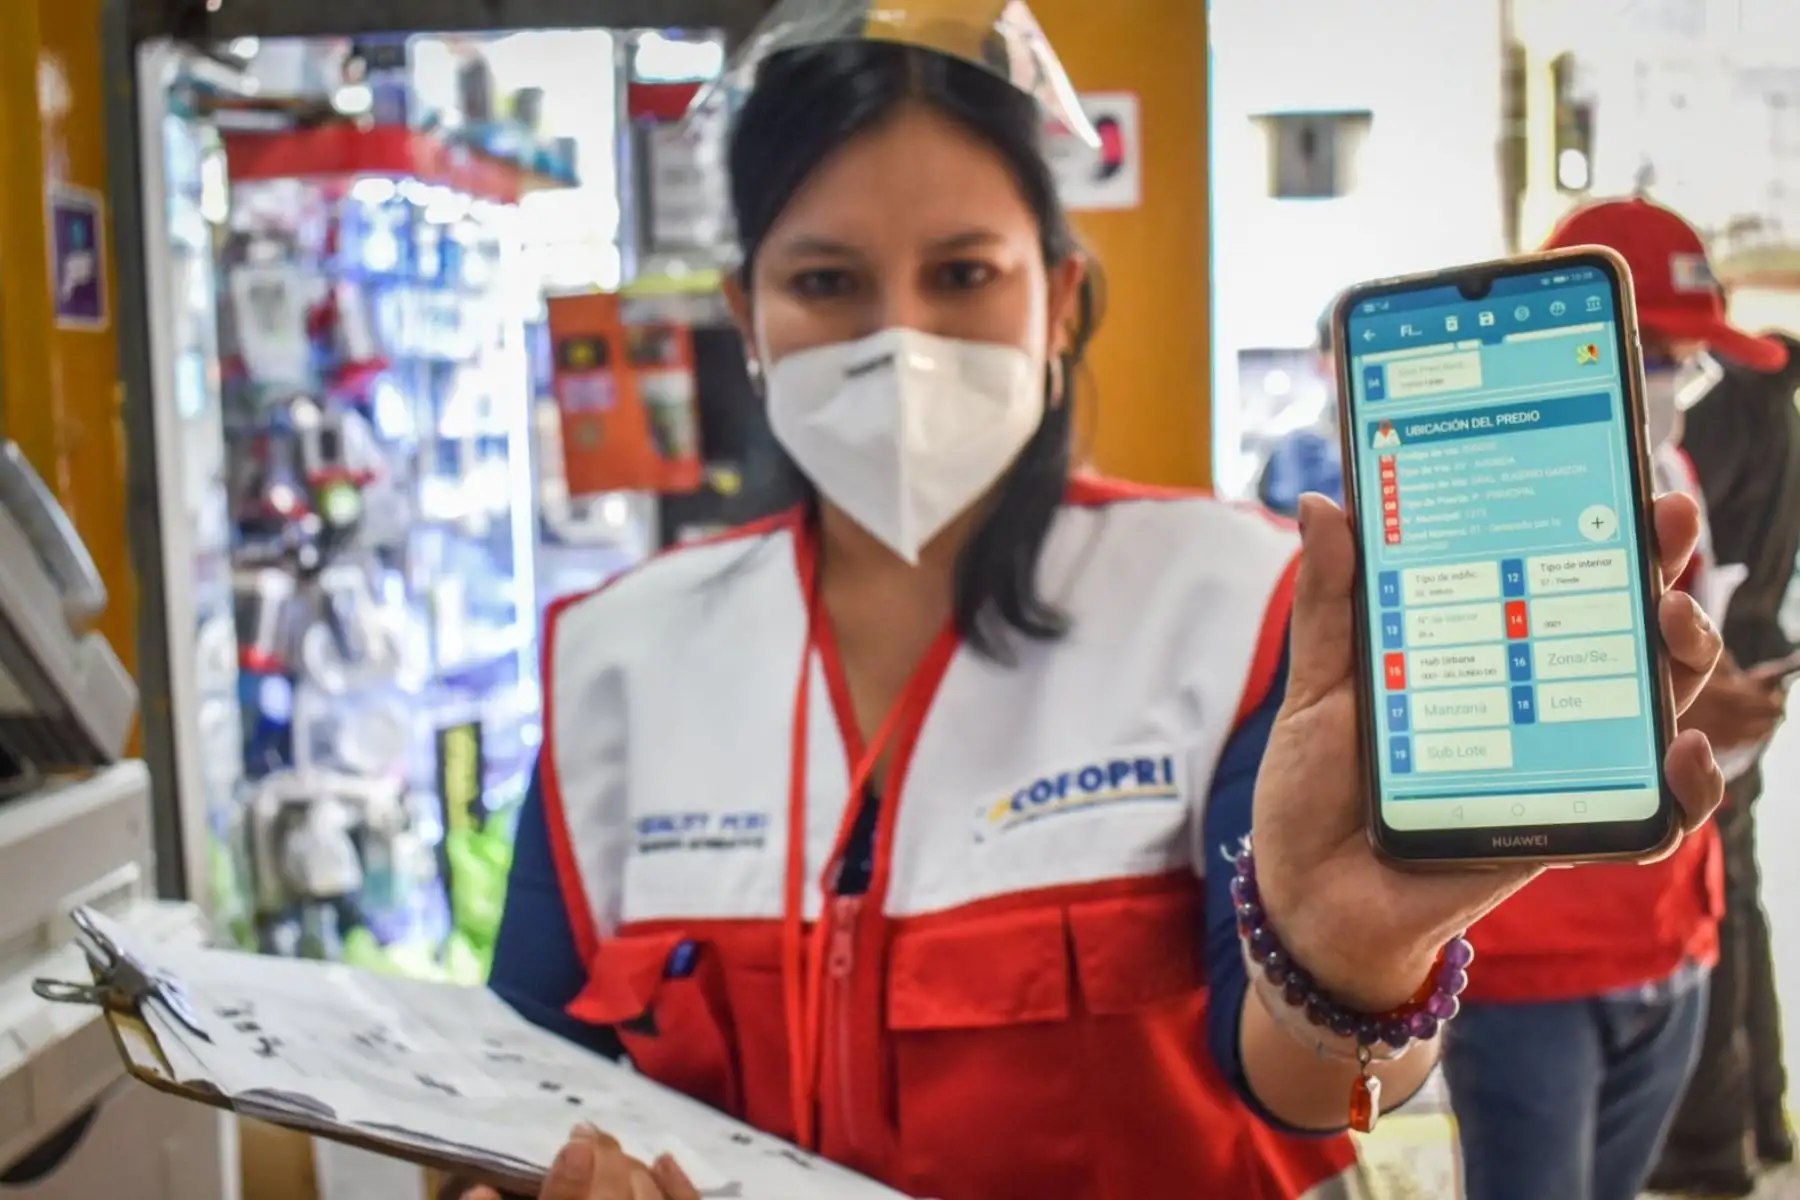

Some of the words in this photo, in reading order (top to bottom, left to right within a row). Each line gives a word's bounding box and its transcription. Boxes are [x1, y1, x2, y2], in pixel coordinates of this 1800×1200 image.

[1405, 418, 1469, 437] UBICACIÓN
[1471, 415, 1495, 429] DEL
[1496, 409, 1541, 426] PREDIO
[1540, 562, 1562, 573] Tipo
[1563, 560, 1577, 570] de
[1578, 558, 1612, 569] interior
[1415, 574, 1436, 585] Tipo
[1437, 571, 1449, 581] de
[1507, 572, 1520, 584] 12
[1384, 584, 1395, 596] 11
[1511, 614, 1523, 625] 14
[1386, 624, 1398, 637] 13
[1441, 654, 1476, 666] Urbana
[1513, 656, 1526, 668] 16
[1517, 699, 1530, 711] 18
[1550, 695, 1583, 709] Lote
[1391, 707, 1404, 719] 17
[1424, 702, 1488, 717] Manzana
[1395, 748, 1408, 760] 19
[1426, 746, 1454, 759] Sub
[1457, 743, 1487, 758] Lote
[1010, 756, 1175, 812] COFOPRI
[1492, 833, 1549, 848] HUAWEI
